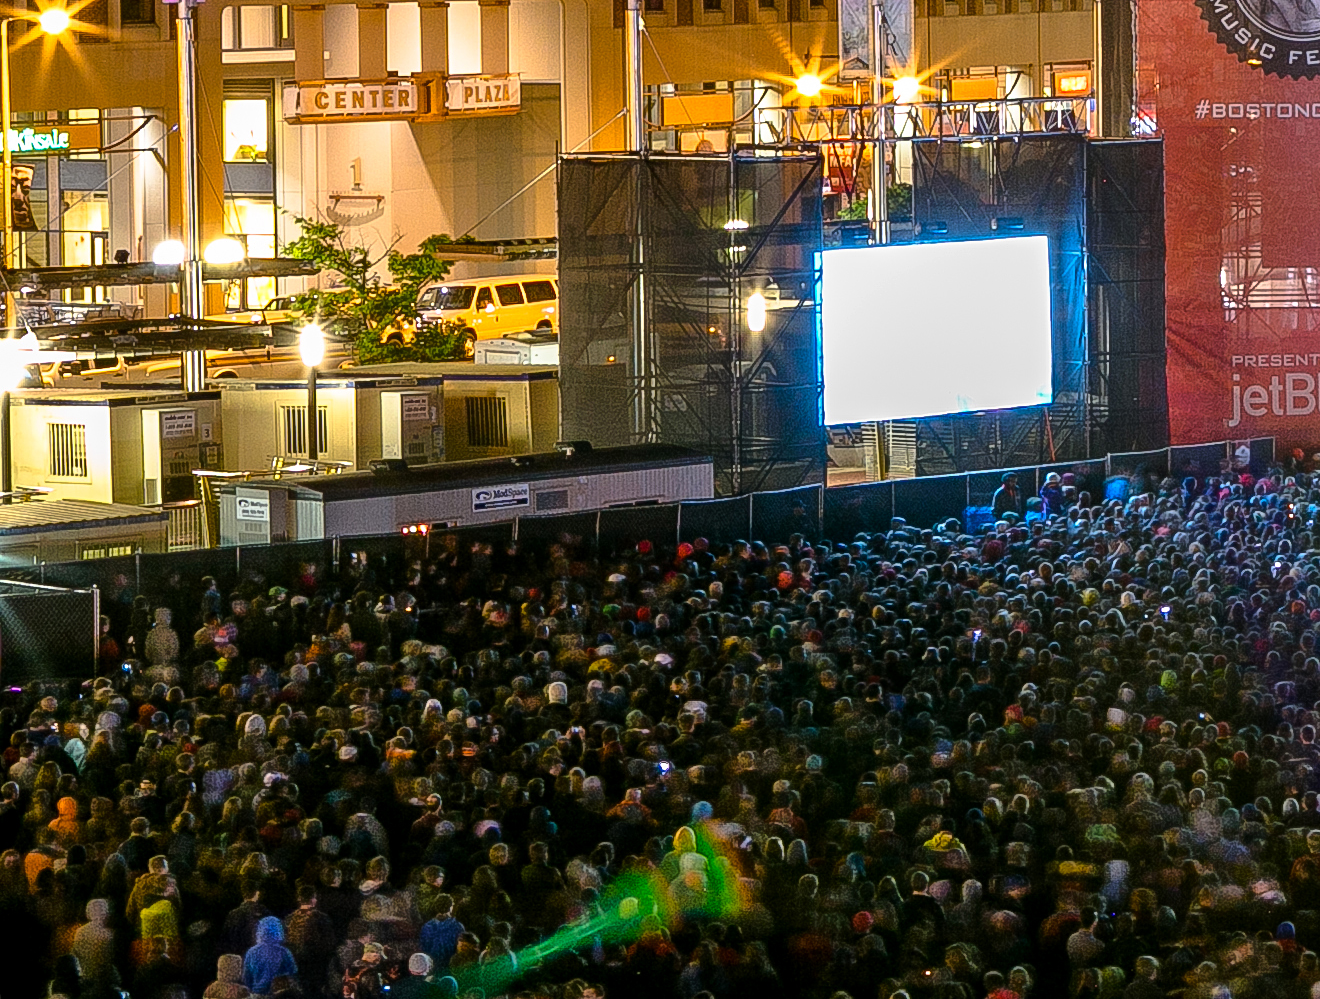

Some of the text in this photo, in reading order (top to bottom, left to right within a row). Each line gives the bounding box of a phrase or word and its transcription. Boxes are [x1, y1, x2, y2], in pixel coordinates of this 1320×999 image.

[314, 89, 410, 110] CENTER
[464, 84, 511, 104] PLAZA
[349, 156, 363, 192] 1
[204, 428, 210, 438] 3
